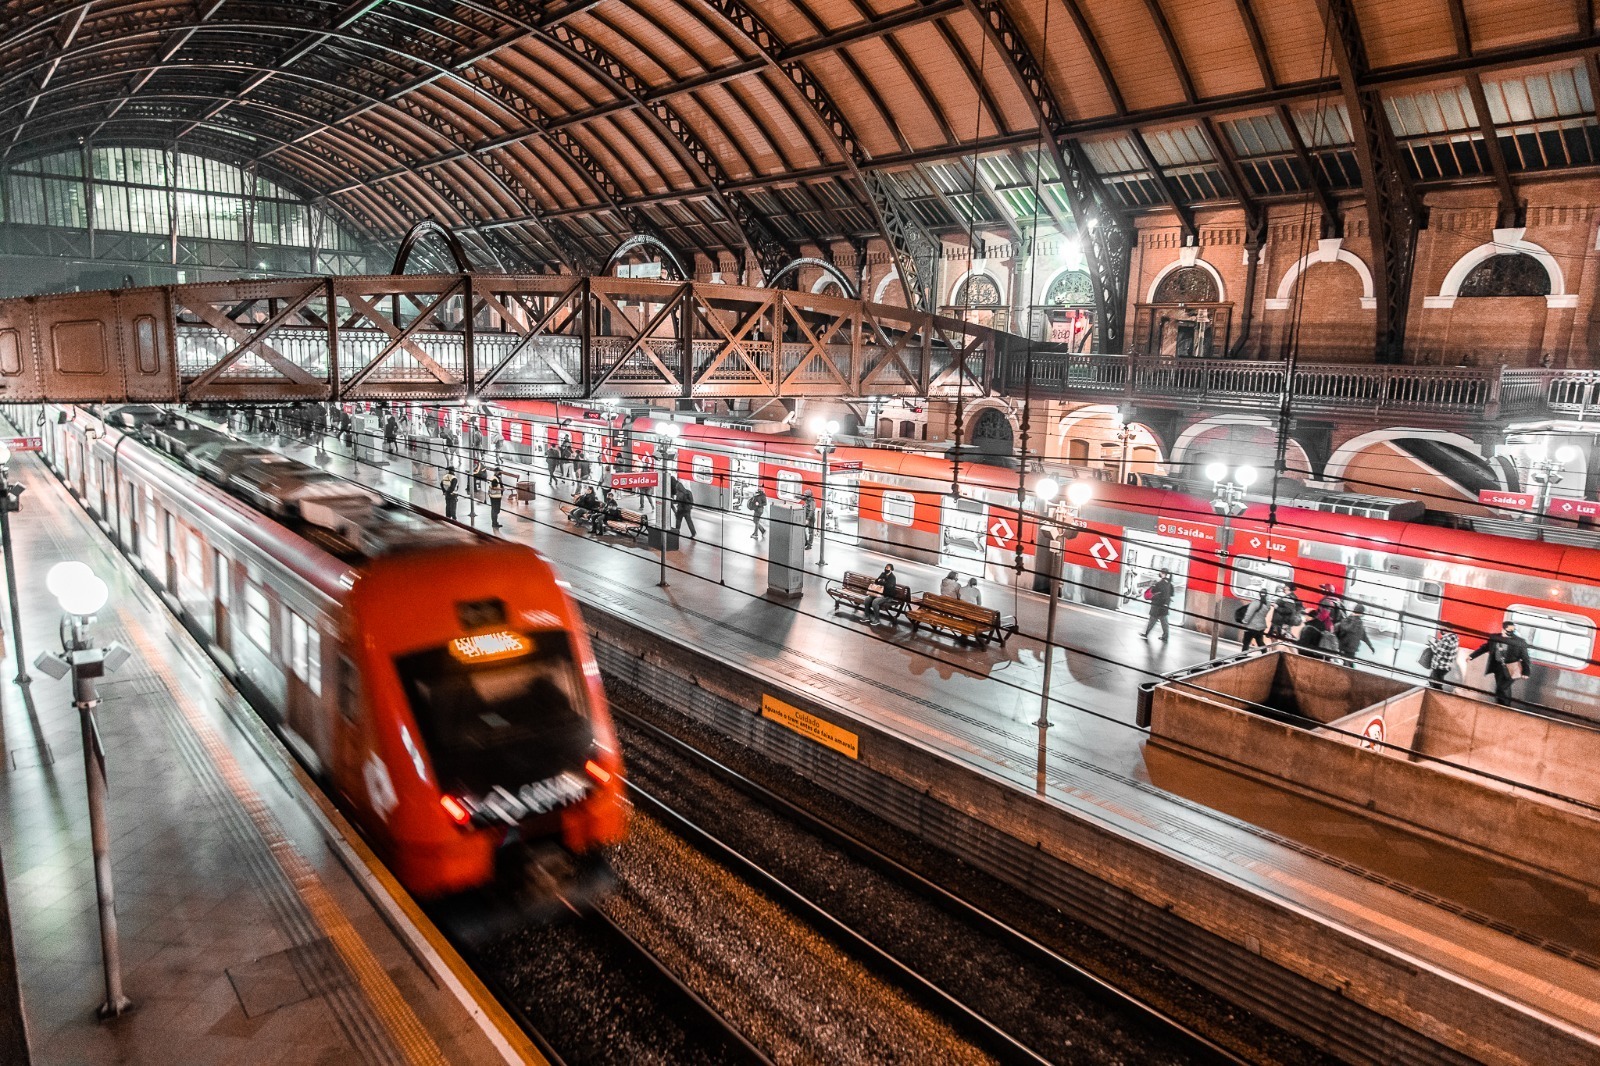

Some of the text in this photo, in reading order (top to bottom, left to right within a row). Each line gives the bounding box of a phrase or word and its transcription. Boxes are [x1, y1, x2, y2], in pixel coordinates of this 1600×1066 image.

[628, 477, 649, 485] Saída
[1492, 496, 1517, 505] Saída
[1576, 505, 1596, 514] Luz
[1177, 527, 1205, 539] Saída
[1265, 540, 1286, 552] Luz
[795, 712, 820, 728] Cuidado
